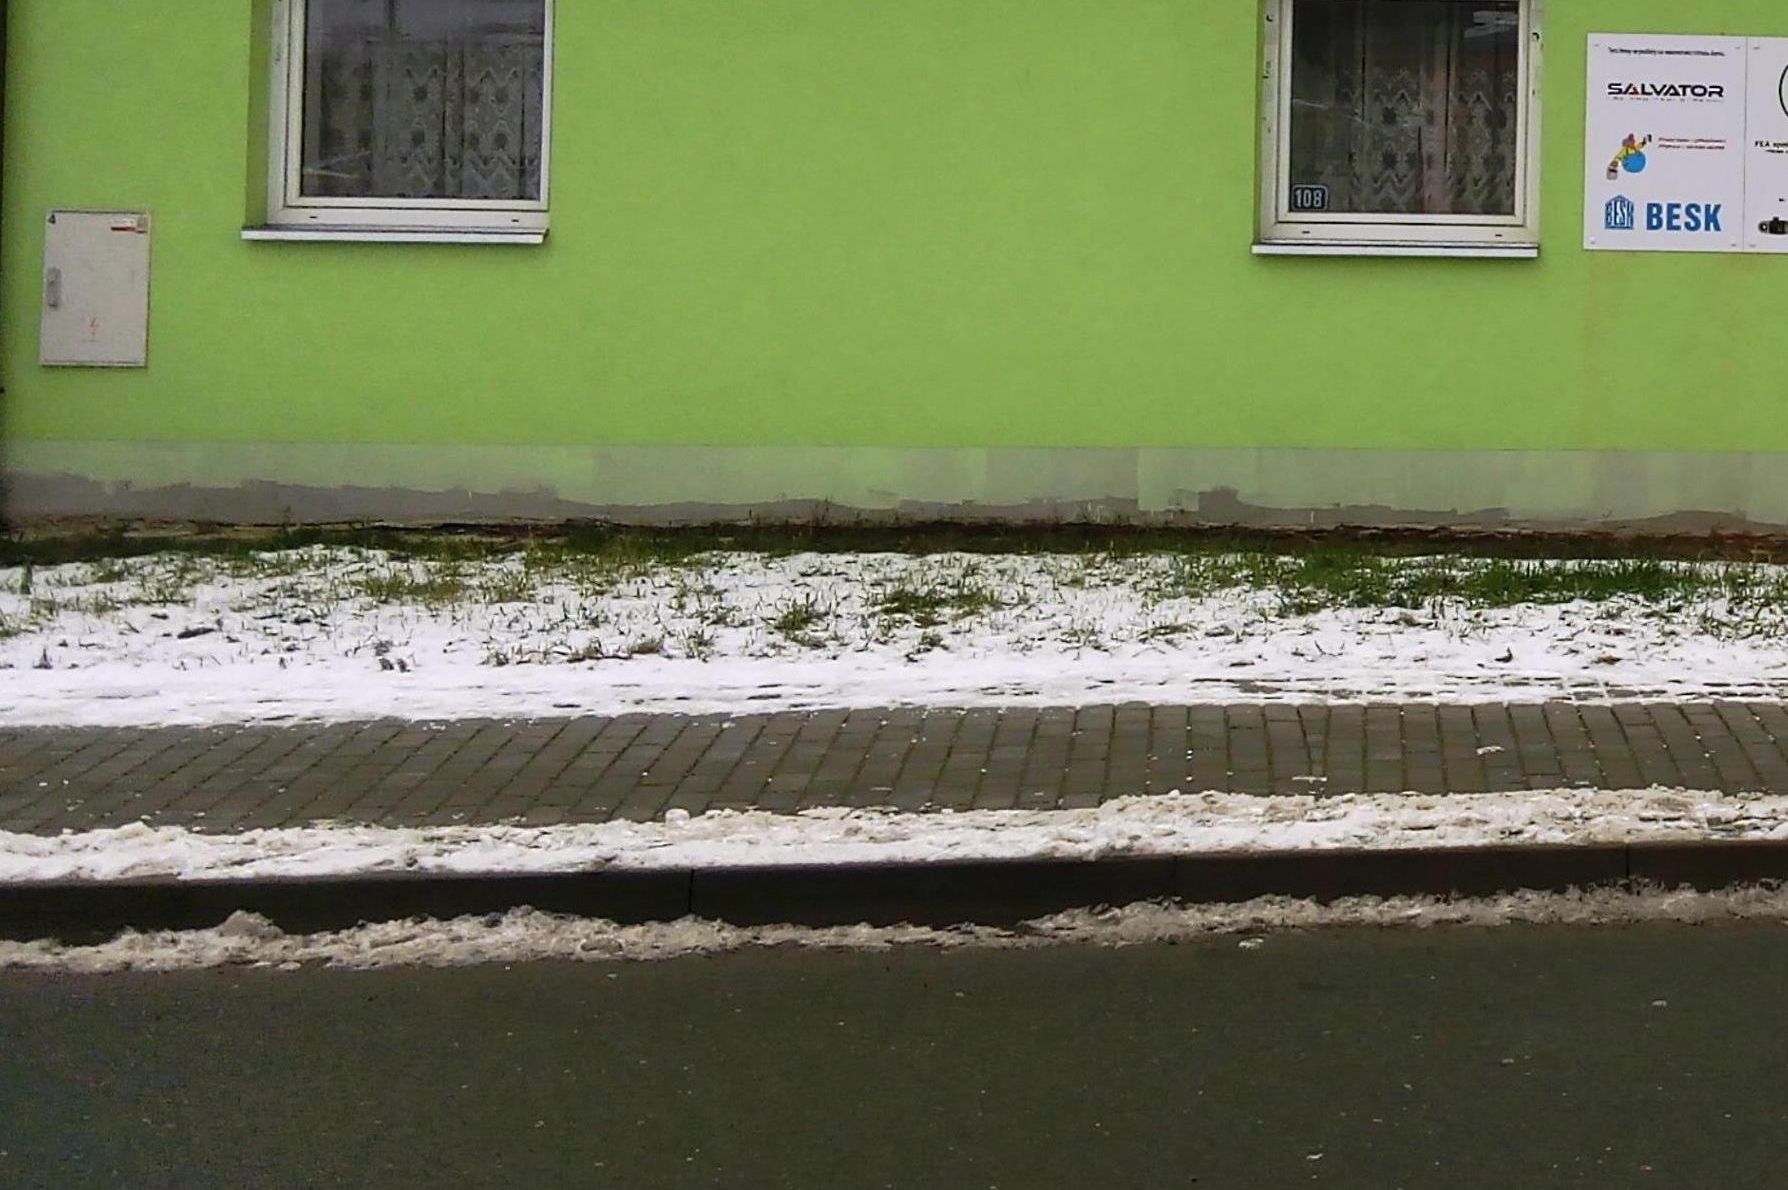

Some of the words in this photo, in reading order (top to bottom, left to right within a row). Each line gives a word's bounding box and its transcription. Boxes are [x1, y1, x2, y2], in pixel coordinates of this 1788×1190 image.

[1608, 83, 1724, 97] SALVATOR
[1754, 140, 1770, 148] FEA
[1295, 190, 1322, 207] 108
[1646, 202, 1722, 231] BESK
